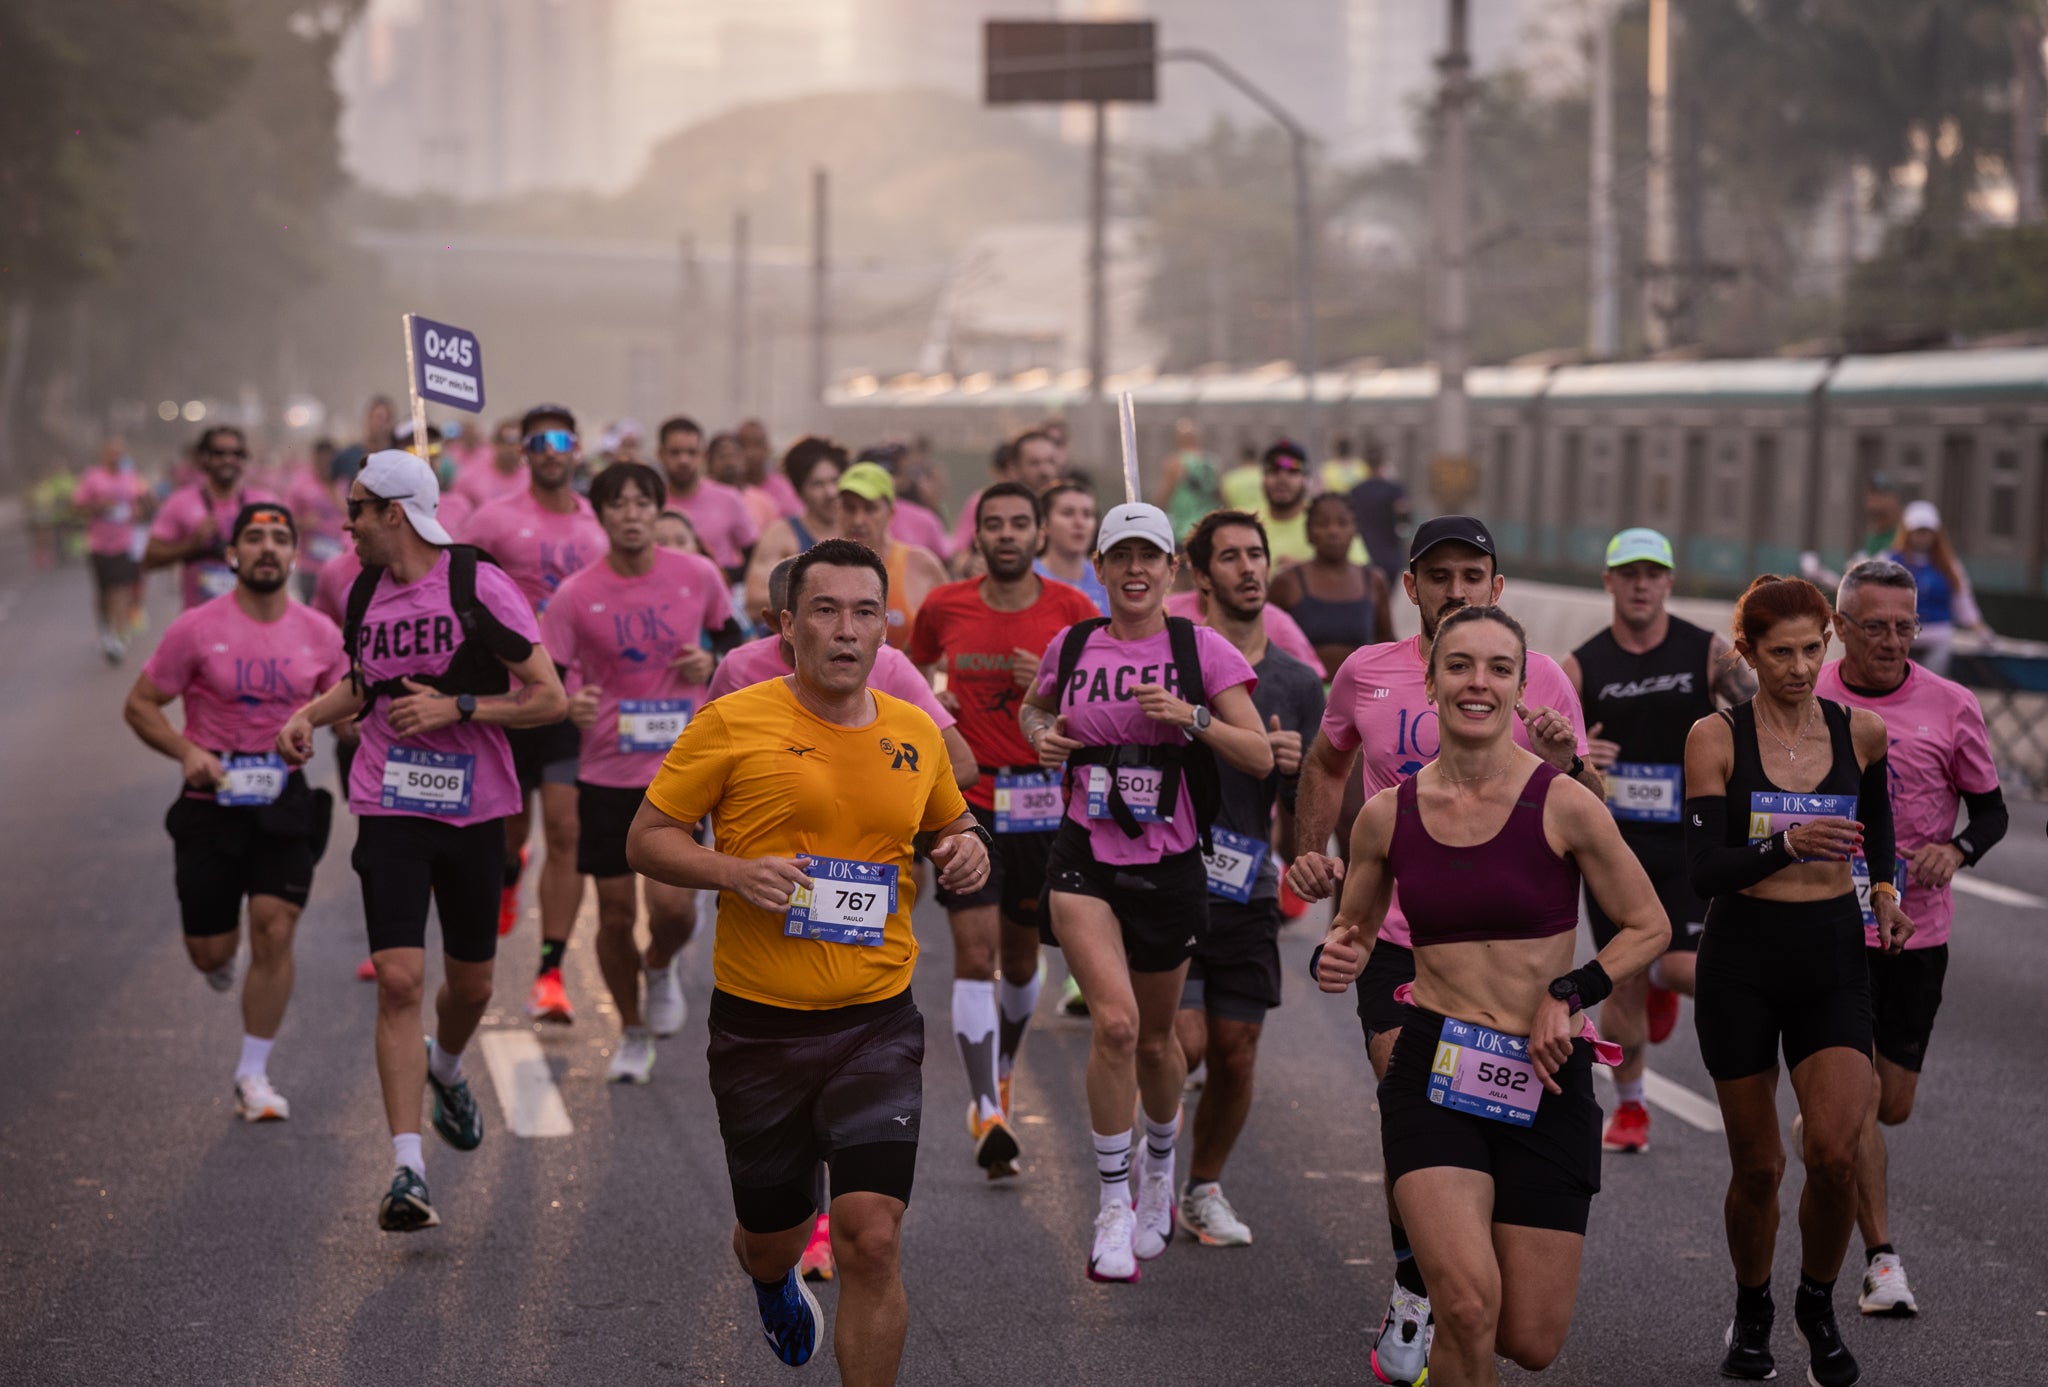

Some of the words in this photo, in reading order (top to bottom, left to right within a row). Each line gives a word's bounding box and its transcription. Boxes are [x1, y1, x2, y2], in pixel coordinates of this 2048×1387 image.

[424, 329, 473, 368] 0:45
[360, 615, 453, 661] PACER
[236, 657, 294, 695] 10K
[1598, 672, 1694, 700] RACER
[408, 771, 460, 791] 5006
[1023, 793, 1056, 809] 320
[1627, 784, 1664, 800] 509
[1782, 796, 1808, 813] 10K
[1824, 798, 1838, 808] SP
[1754, 817, 1765, 835] A
[828, 861, 856, 879] 10K
[796, 886, 807, 902] A
[835, 890, 877, 912] 767
[791, 907, 806, 917] 10K
[1454, 1026, 1467, 1034] nu
[1475, 1030, 1507, 1053] 10K
[1439, 1048, 1451, 1071] A
[1433, 1075, 1449, 1086] 10K
[1477, 1062, 1529, 1092] 582
[1489, 1091, 1507, 1100] JULIA
[1487, 1104, 1502, 1113] rvb
